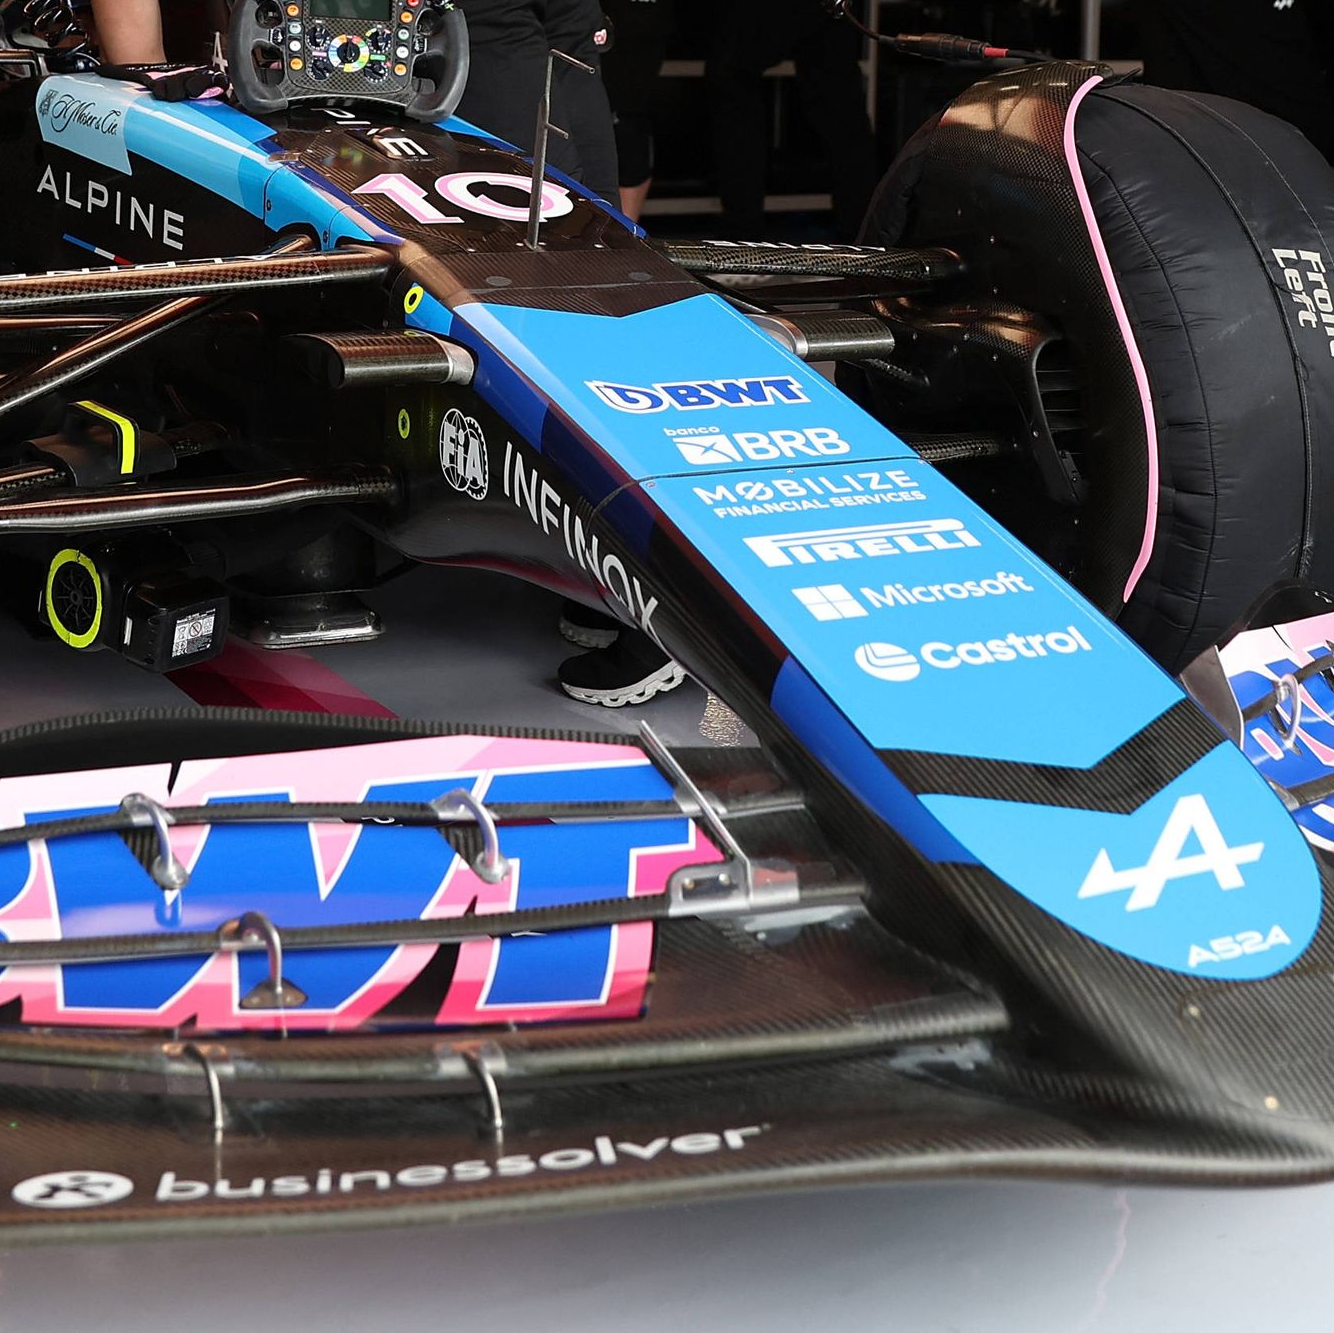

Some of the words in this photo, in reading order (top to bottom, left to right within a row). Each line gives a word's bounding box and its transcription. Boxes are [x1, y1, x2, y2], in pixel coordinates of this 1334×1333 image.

[37, 164, 184, 250] ALPINE
[351, 171, 574, 224] 10
[1272, 248, 1318, 328] Left
[661, 376, 811, 411] BWT
[663, 426, 720, 437] banco
[733, 427, 851, 462] BRB
[714, 498, 831, 519] FINANCIAL
[832, 490, 927, 508] SERVICES
[504, 441, 672, 657] INFINOX
[742, 518, 982, 568] PIRELLI
[860, 572, 1034, 608] Microsoft
[920, 626, 1093, 669] Castrol
[157, 1126, 763, 1202] businessolver
